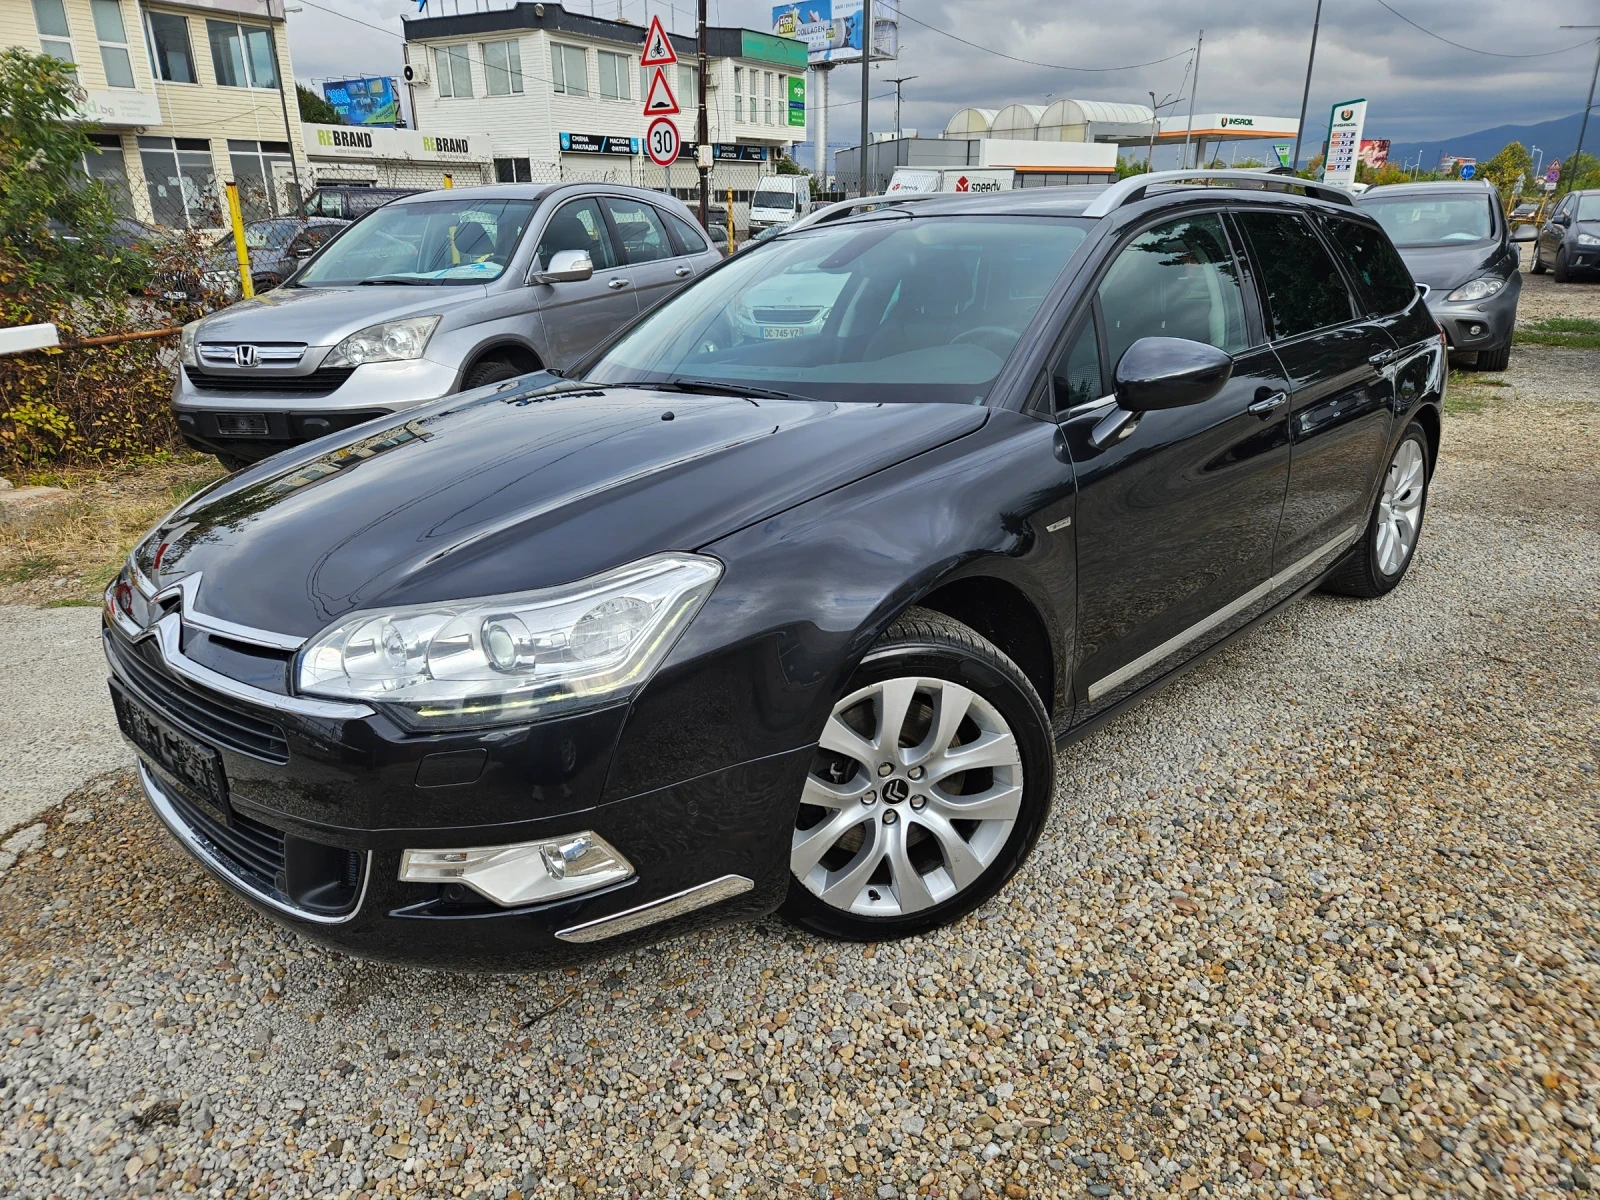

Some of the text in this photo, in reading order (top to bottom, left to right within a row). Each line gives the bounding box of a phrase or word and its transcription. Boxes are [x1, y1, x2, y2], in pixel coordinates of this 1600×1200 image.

[780, 16, 792, 24] rice
[797, 25, 825, 36] COLLAGEN
[794, 87, 804, 97] ogo
[1229, 118, 1254, 126] INSAOIL
[317, 129, 373, 148] REBRAND
[653, 130, 672, 154] 30
[422, 136, 469, 153] REBRAND
[572, 143, 599, 151] НАКЛАДКИ
[764, 328, 799, 338] DC-745-VZ
